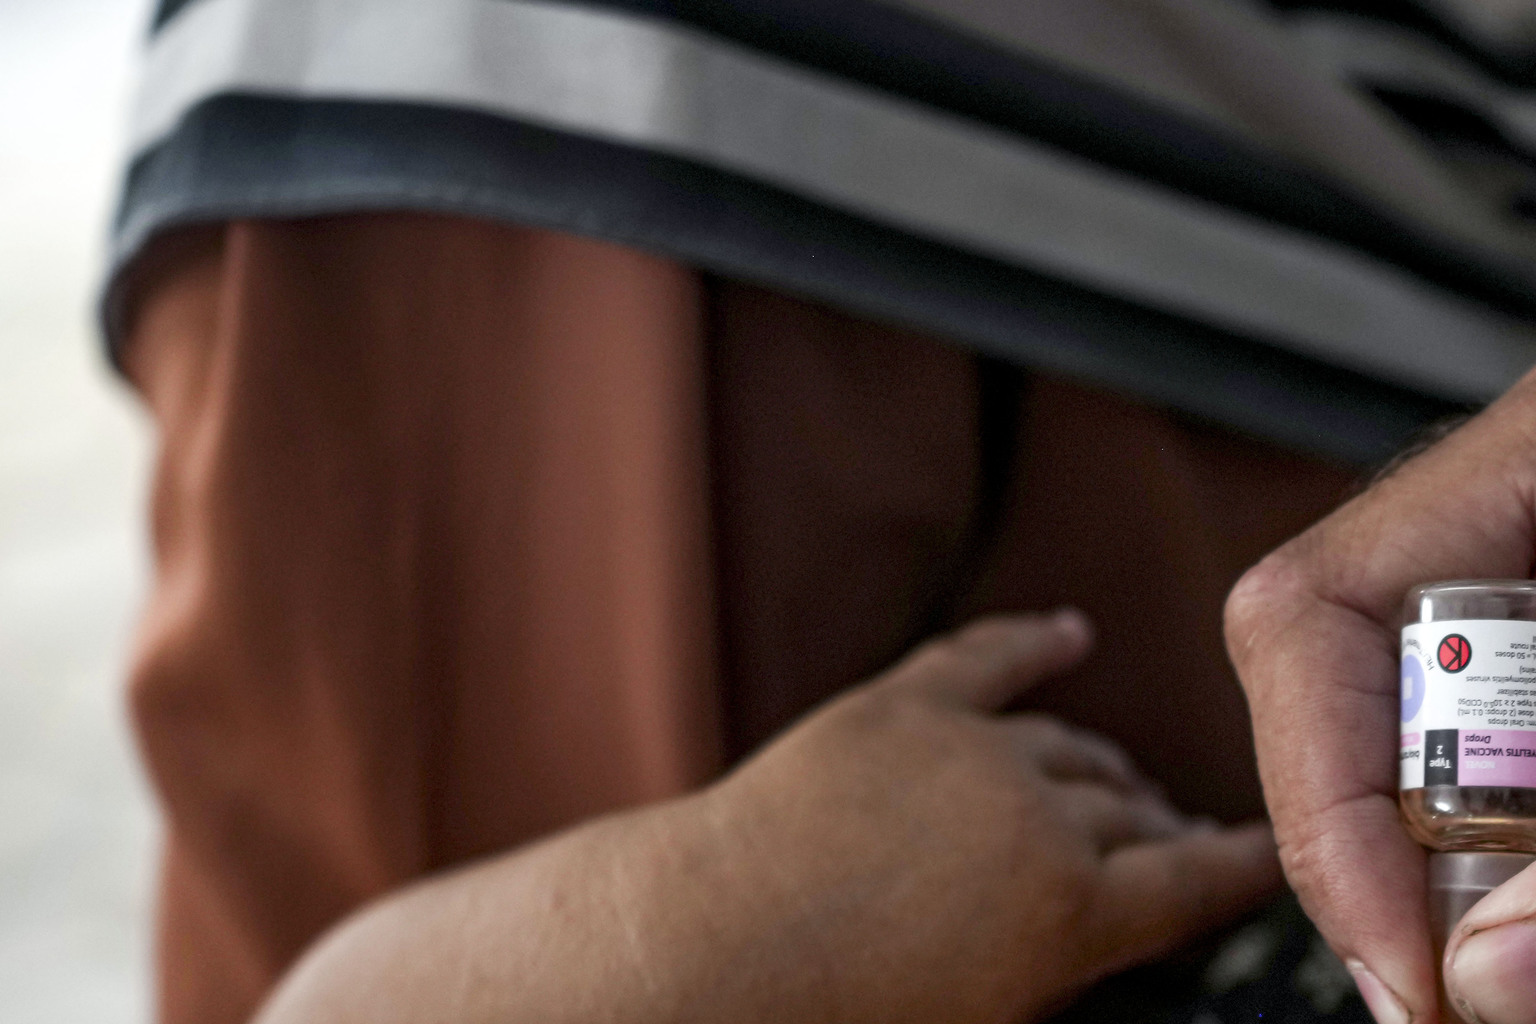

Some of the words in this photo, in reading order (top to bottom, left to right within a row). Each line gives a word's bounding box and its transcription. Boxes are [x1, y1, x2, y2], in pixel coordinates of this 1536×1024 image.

[1492, 675, 1536, 684] poliomyelitis
[1517, 699, 1532, 707] type
[1488, 718, 1508, 726] drops
[1510, 719, 1525, 727] Oral
[1465, 734, 1491, 744] Drops
[1437, 745, 1443, 755] 2
[1465, 748, 1504, 756] VACCINE
[1429, 757, 1451, 769] Type
[1465, 761, 1495, 769] NOVEL
